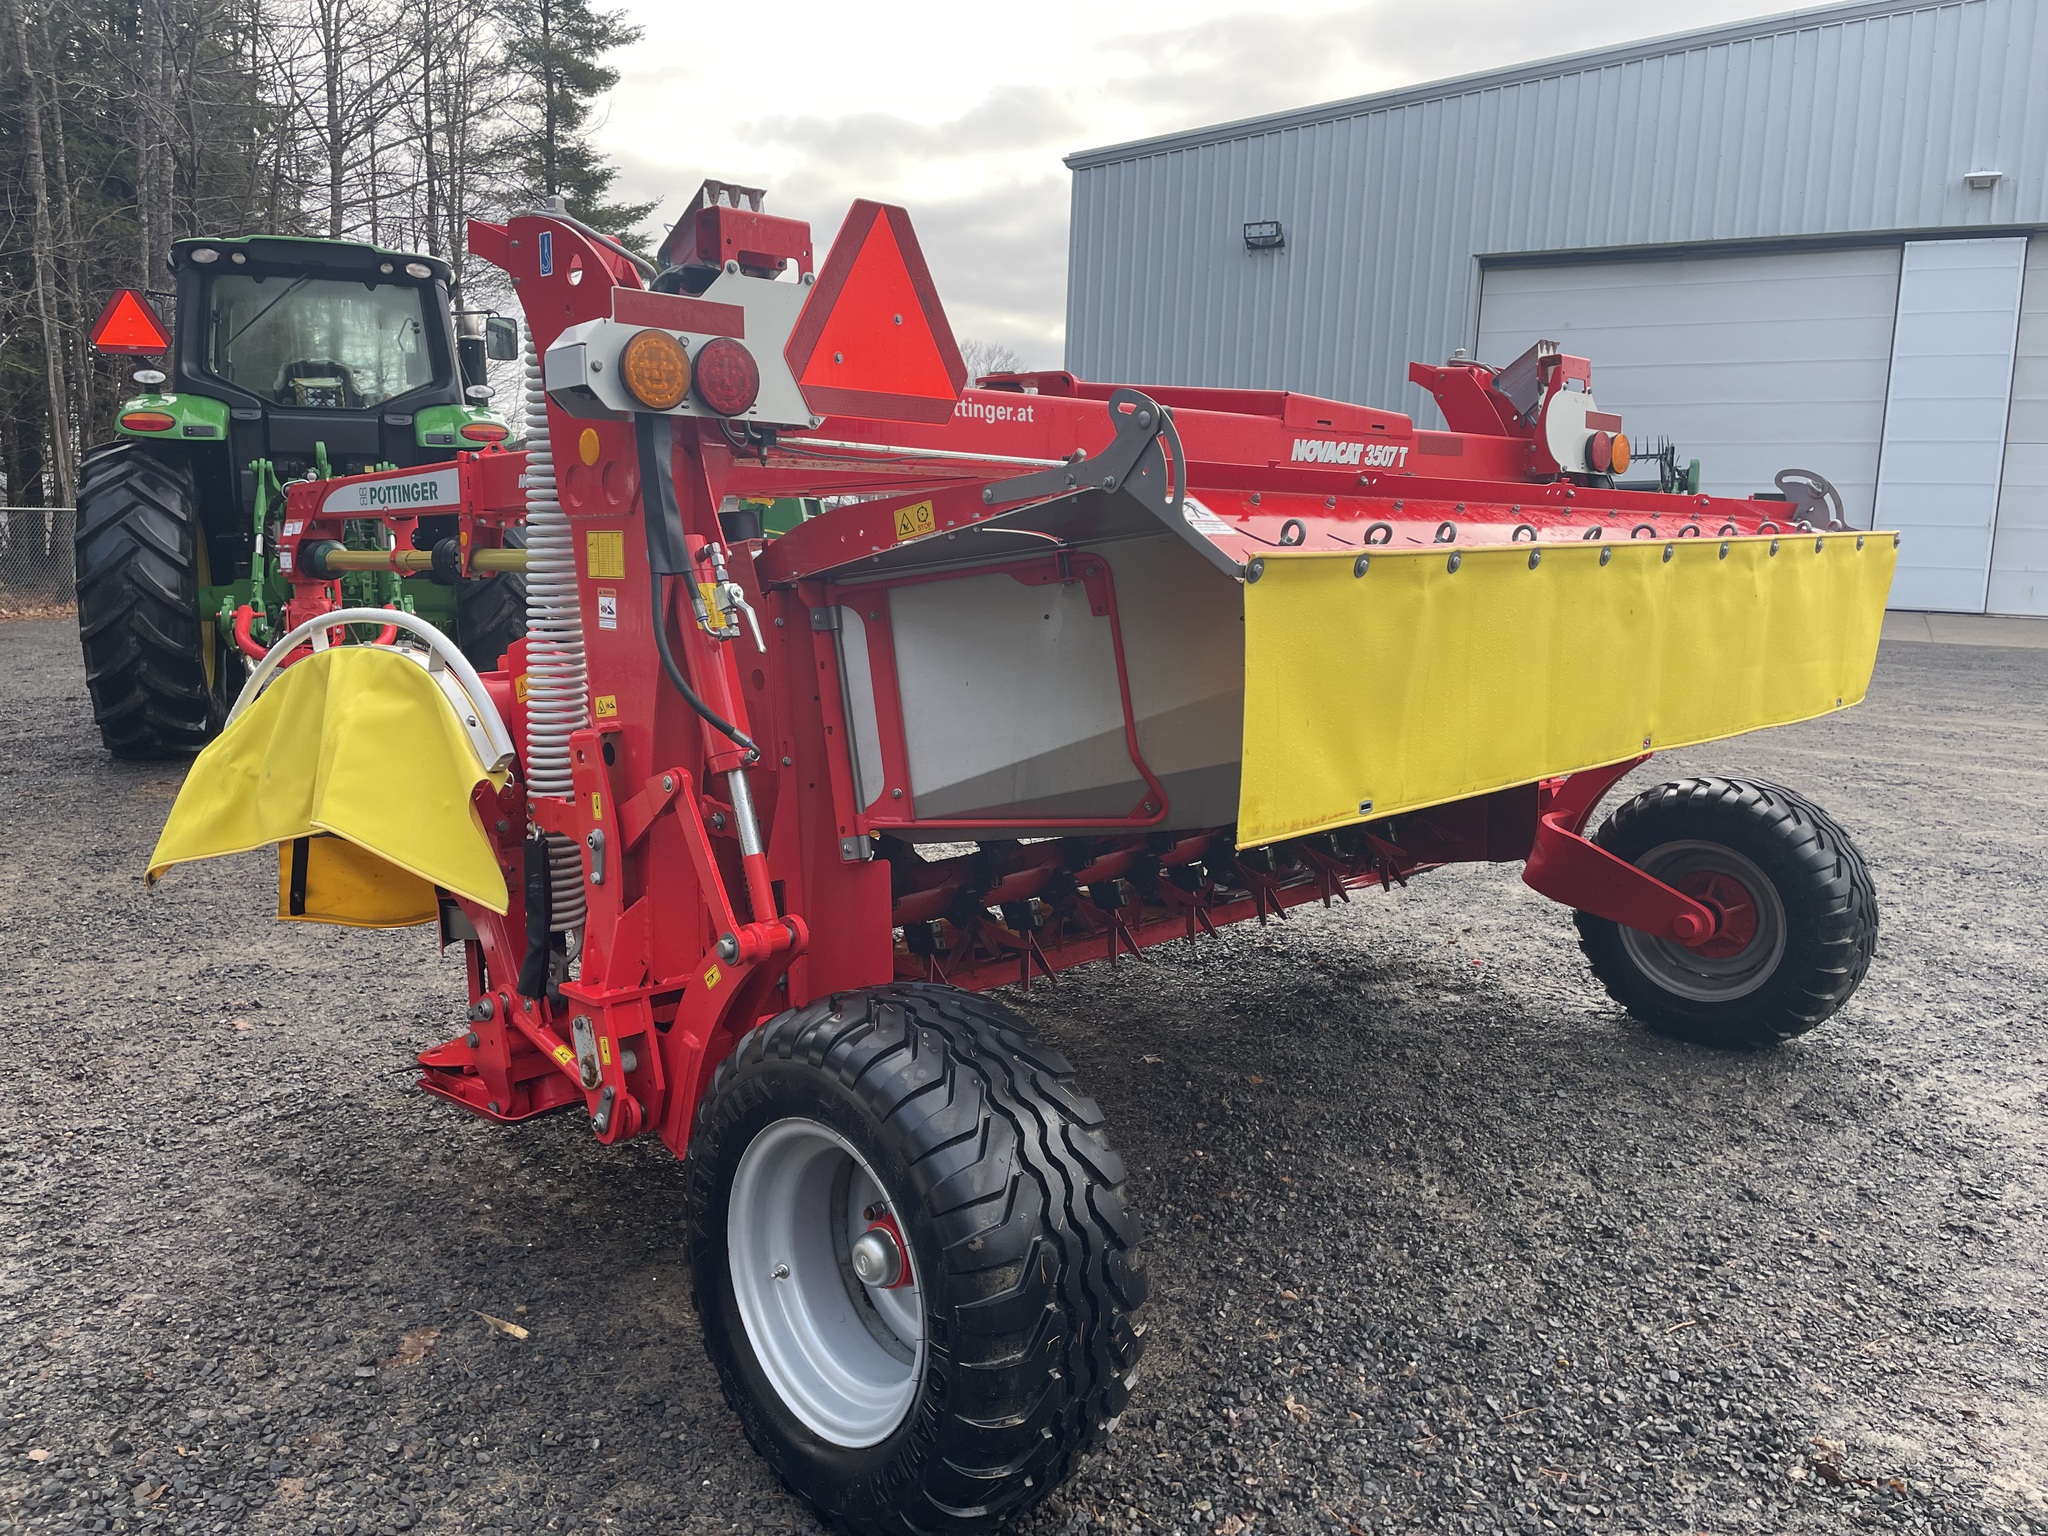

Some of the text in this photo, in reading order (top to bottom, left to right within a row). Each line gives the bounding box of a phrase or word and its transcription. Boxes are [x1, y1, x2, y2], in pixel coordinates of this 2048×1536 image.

[954, 397, 1034, 424] ttinger.at
[1291, 439, 1409, 468] NOVACAT 3507 T
[917, 521, 932, 531] STOP
